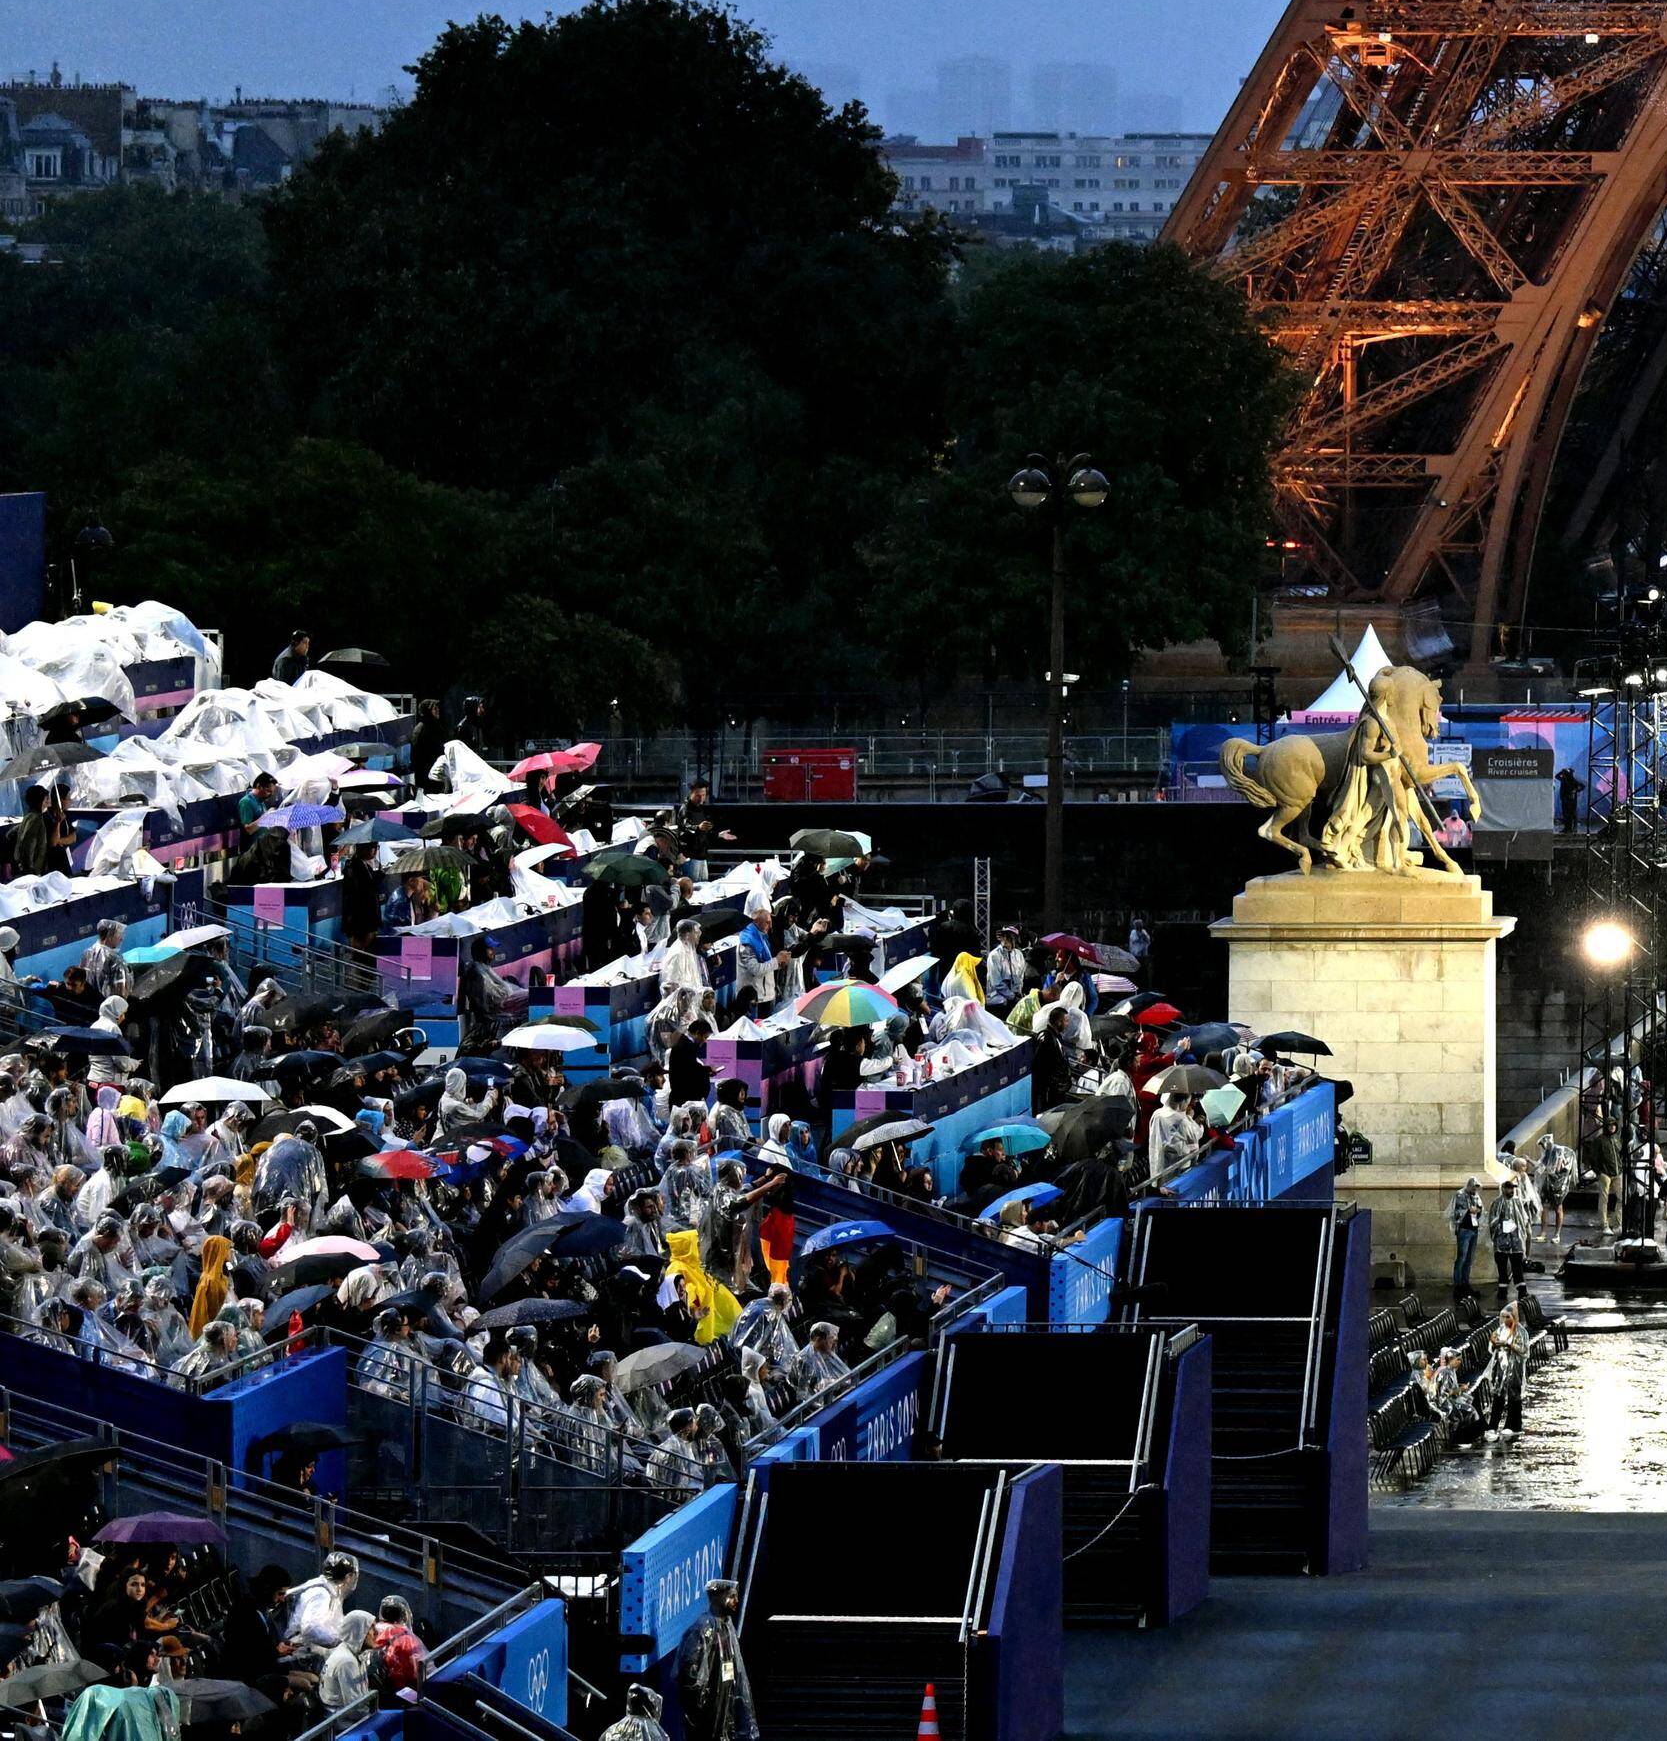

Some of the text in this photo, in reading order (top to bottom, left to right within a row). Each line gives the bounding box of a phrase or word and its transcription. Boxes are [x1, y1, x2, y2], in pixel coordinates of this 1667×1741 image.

[1305, 715, 1341, 724] Entrée
[1488, 757, 1539, 767] Croisières
[1488, 768, 1539, 776] River cruises
[1315, 1109, 1330, 1149] 2024
[897, 1389, 920, 1445] 2024
[694, 1535, 724, 1601] 2024
